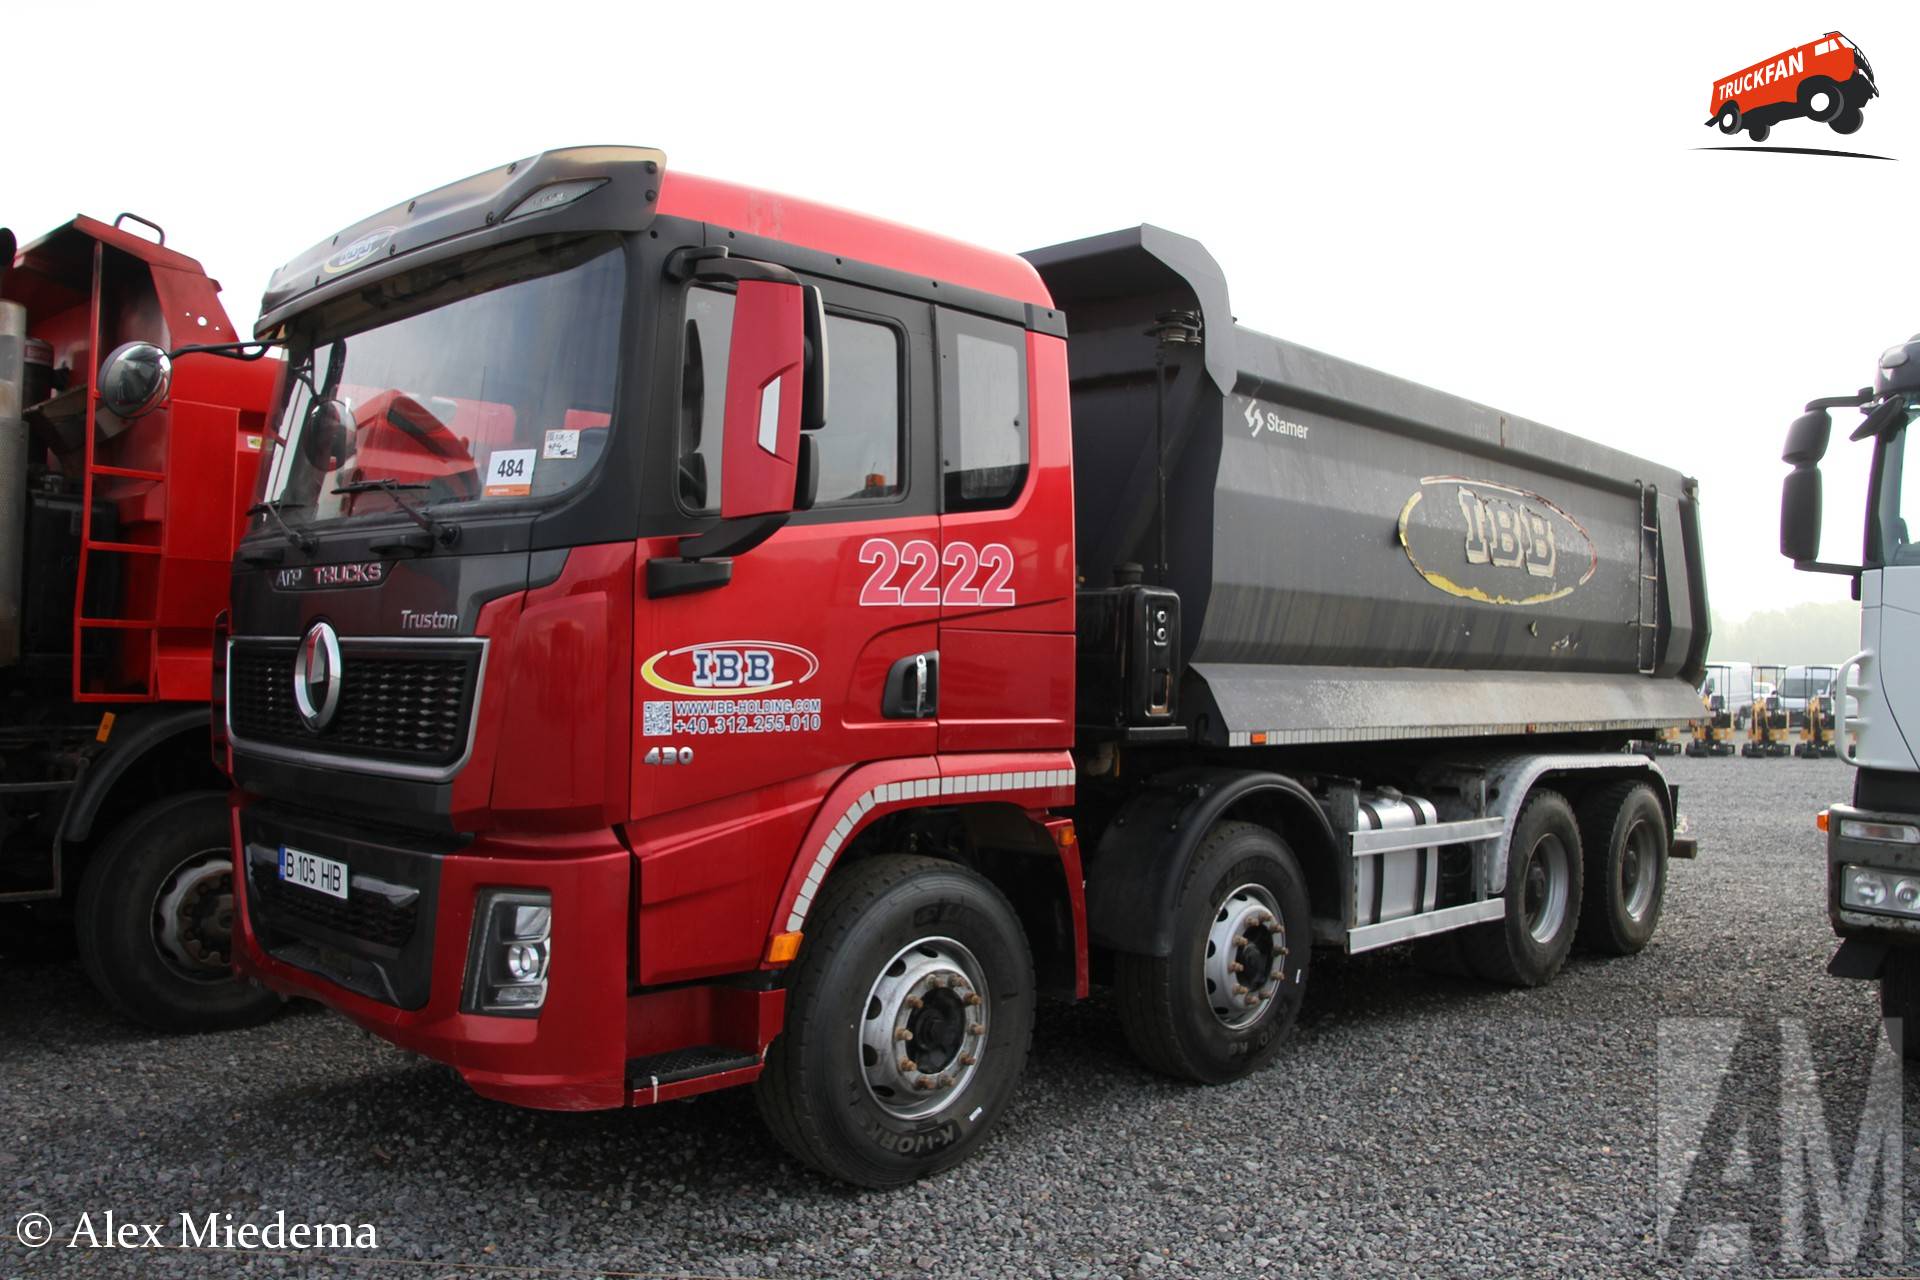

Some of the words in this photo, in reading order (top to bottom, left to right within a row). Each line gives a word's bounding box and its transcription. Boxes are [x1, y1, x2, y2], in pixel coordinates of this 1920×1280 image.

[1266, 411, 1309, 439] Stamer
[497, 458, 524, 478] 484
[1457, 485, 1556, 578] IBB
[313, 562, 382, 584] TRUCKS
[859, 538, 1015, 606] 2222
[401, 609, 458, 629] Truston
[692, 650, 774, 687] IBB
[674, 699, 821, 716] WWW.IBB-HOLDING.COM
[674, 714, 821, 735] +40.312.255.010
[644, 746, 694, 765] 430
[286, 852, 295, 878] B
[299, 855, 316, 885] 105
[321, 861, 341, 892] HIB
